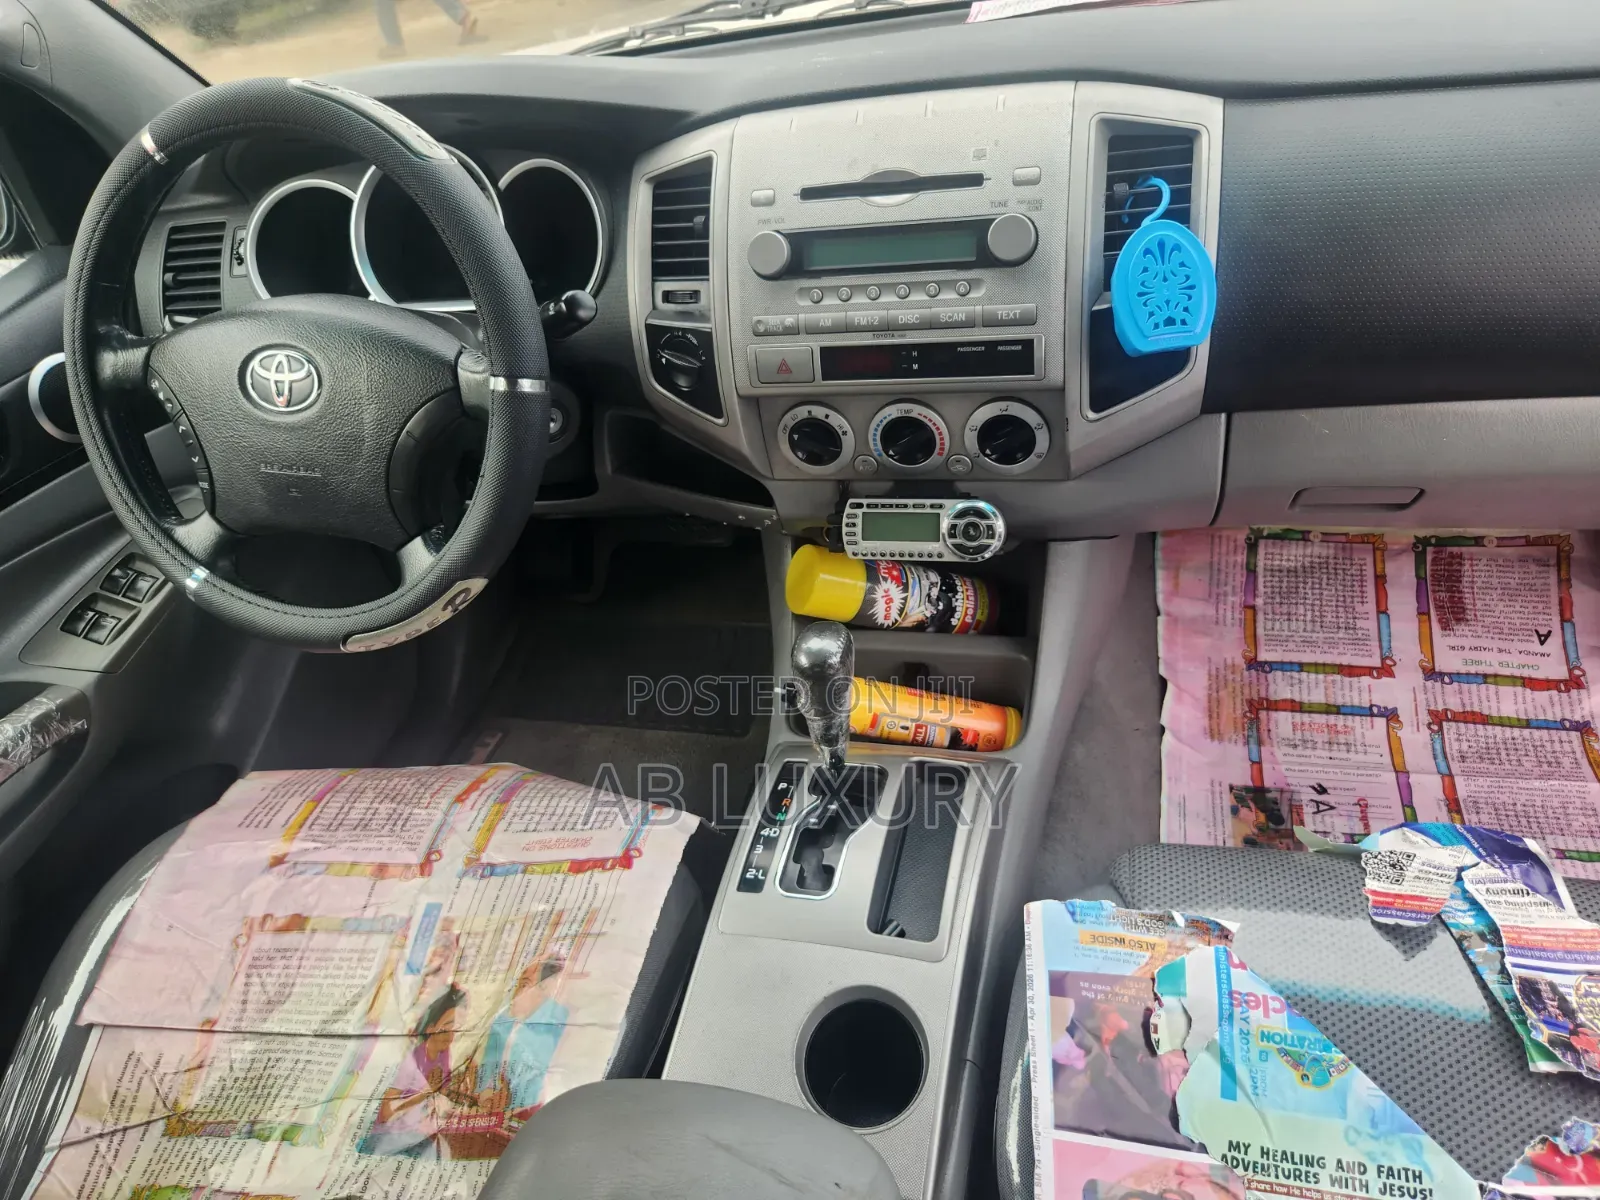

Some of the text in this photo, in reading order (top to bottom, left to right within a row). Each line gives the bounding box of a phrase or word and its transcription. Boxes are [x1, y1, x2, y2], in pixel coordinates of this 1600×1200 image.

[819, 318, 832, 327] AM
[898, 315, 920, 324] DISC
[940, 312, 966, 322] SCAN
[996, 310, 1021, 320] TEXT
[896, 408, 914, 416] TEMP
[782, 413, 843, 435] OFF LO HI
[881, 588, 894, 620] magic
[358, 586, 472, 651] TYPE R
[1496, 646, 1512, 654] THE
[1462, 658, 1540, 671] CHAPTER THREE
[777, 782, 788, 790] P
[781, 798, 792, 806] R
[776, 812, 786, 821] N
[521, 841, 592, 852] QUESTIONS ON
[753, 844, 764, 854] 3
[1109, 914, 1164, 928] GOD'S LIGHT
[1025, 930, 1032, 942] AM
[1124, 924, 1165, 937] SEE WITH
[1089, 933, 1156, 951] ALSO INSIDE
[1026, 974, 1034, 991] 2026
[1028, 1006, 1036, 1021] Apr
[1029, 1034, 1037, 1058] Sheet
[1030, 1060, 1038, 1083] Press
[1247, 1067, 1259, 1096] 2PM
[348, 1131, 359, 1147] can
[355, 1114, 366, 1130] put
[361, 1098, 372, 1115] this
[369, 1073, 386, 1101] money
[1030, 1096, 1042, 1150] Single-sided
[403, 1150, 421, 1180] money
[1228, 1140, 1424, 1185] MY HEALING AND FAITH
[388, 1157, 405, 1188] smiled.
[469, 1161, 486, 1198] you put
[1220, 1153, 1434, 1200] ADVENTURES WITH JESUS!
[1250, 1181, 1272, 1190] share
[1273, 1183, 1288, 1192] how
[1289, 1185, 1301, 1195] He
[1302, 1189, 1322, 1198] helps
[1323, 1192, 1334, 1200] us
